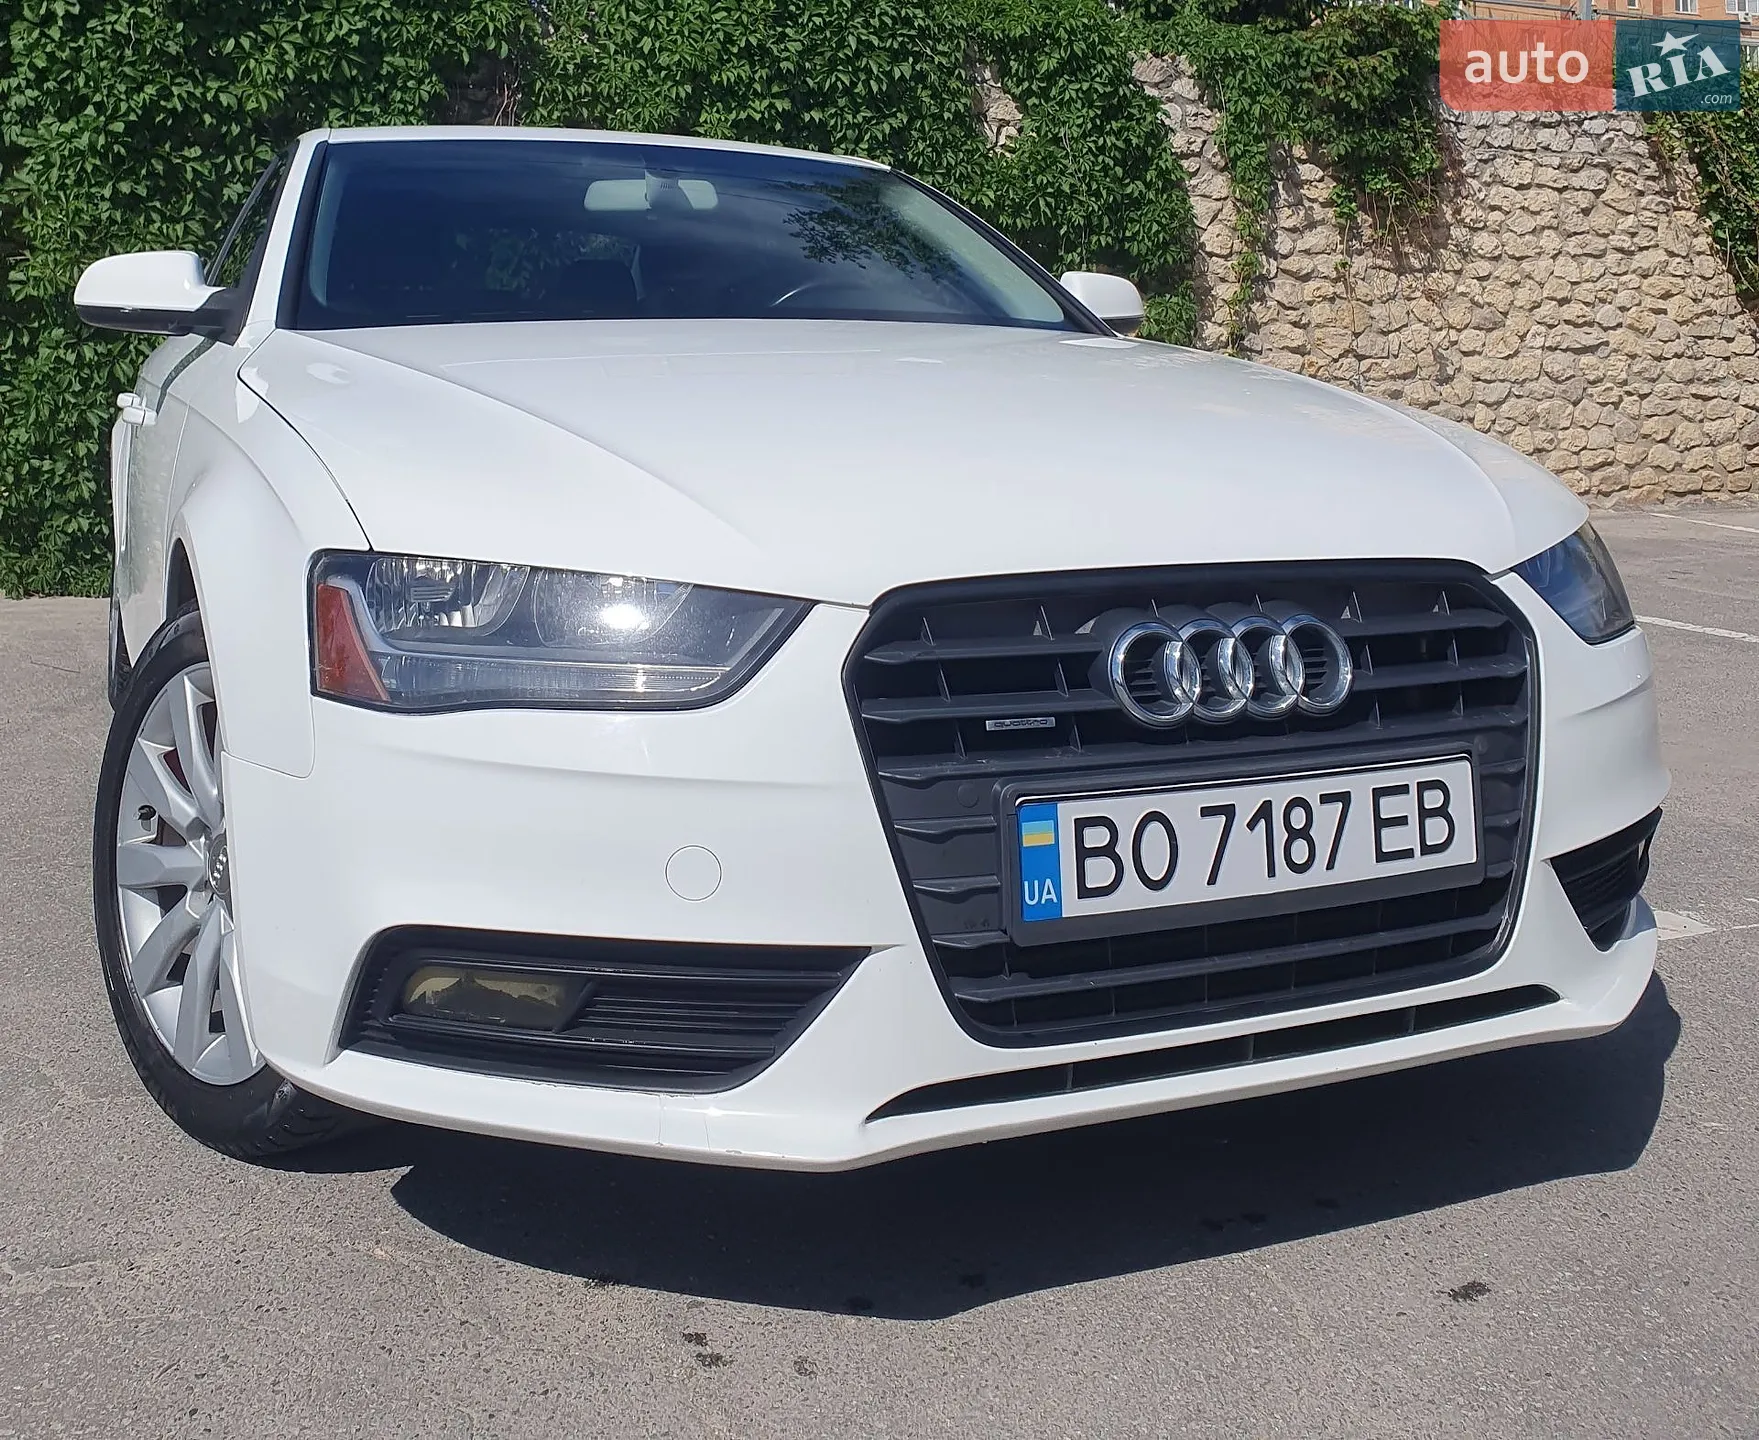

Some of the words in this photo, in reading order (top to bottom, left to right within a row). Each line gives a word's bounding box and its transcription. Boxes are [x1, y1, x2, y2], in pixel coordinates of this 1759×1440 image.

[1073, 810, 1178, 900] BO
[1199, 790, 1352, 886] 7187
[1372, 779, 1456, 864] EB
[1023, 879, 1058, 906] UA
